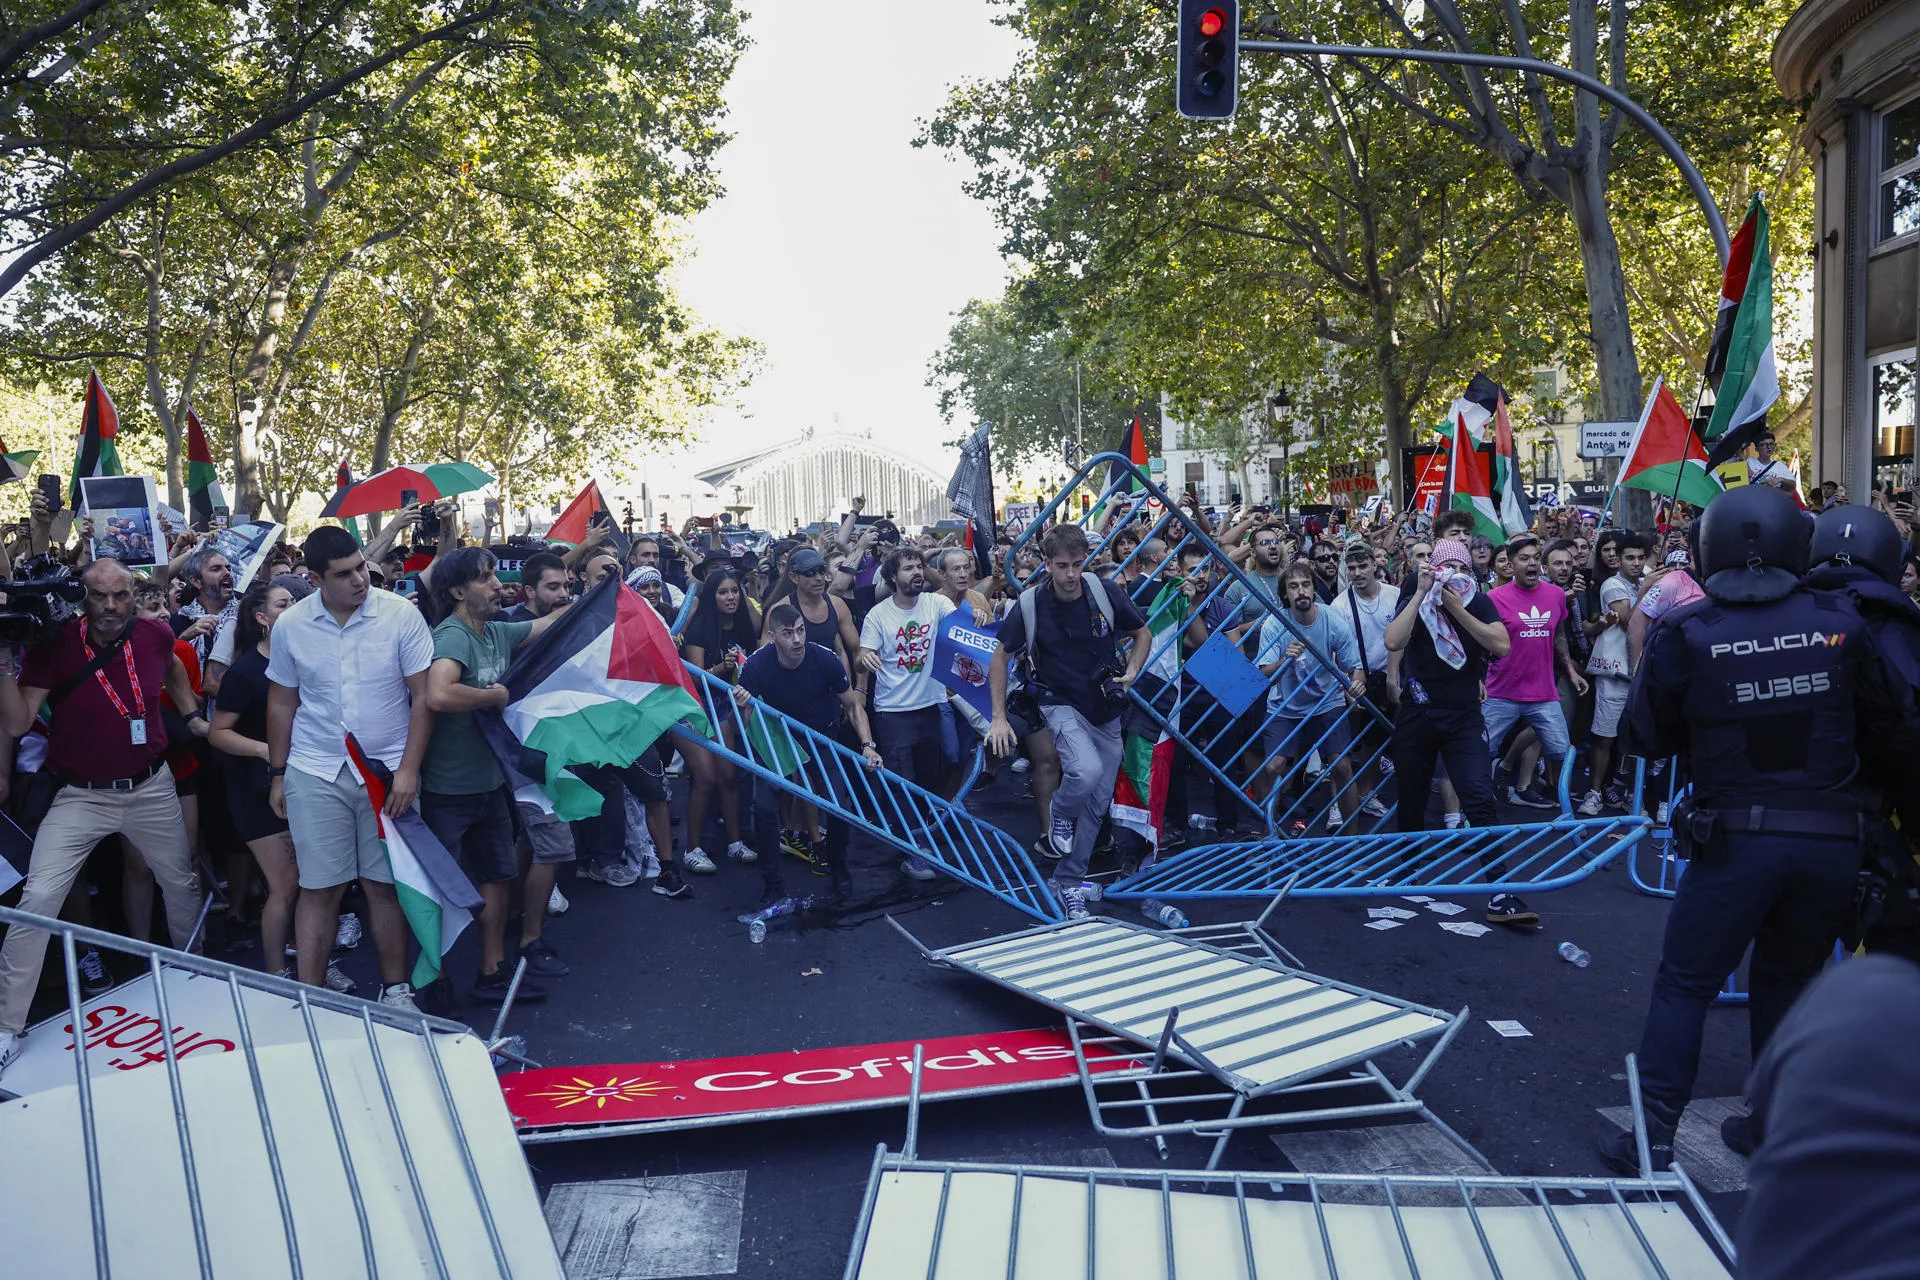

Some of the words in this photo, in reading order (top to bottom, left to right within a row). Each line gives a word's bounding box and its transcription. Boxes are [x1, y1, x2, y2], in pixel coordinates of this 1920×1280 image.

[1586, 430, 1617, 438] mercado
[1621, 430, 1631, 438] de
[1330, 476, 1378, 495] MIERDA
[1522, 483, 1577, 498] RRA
[1007, 507, 1030, 519] FREE
[896, 624, 931, 641] ARO
[954, 629, 999, 650] PRESS
[1519, 628, 1550, 638] adidas
[896, 638, 931, 656] ARO
[1710, 632, 1828, 659] POLICIA
[693, 1043, 1073, 1093] Cofidis
